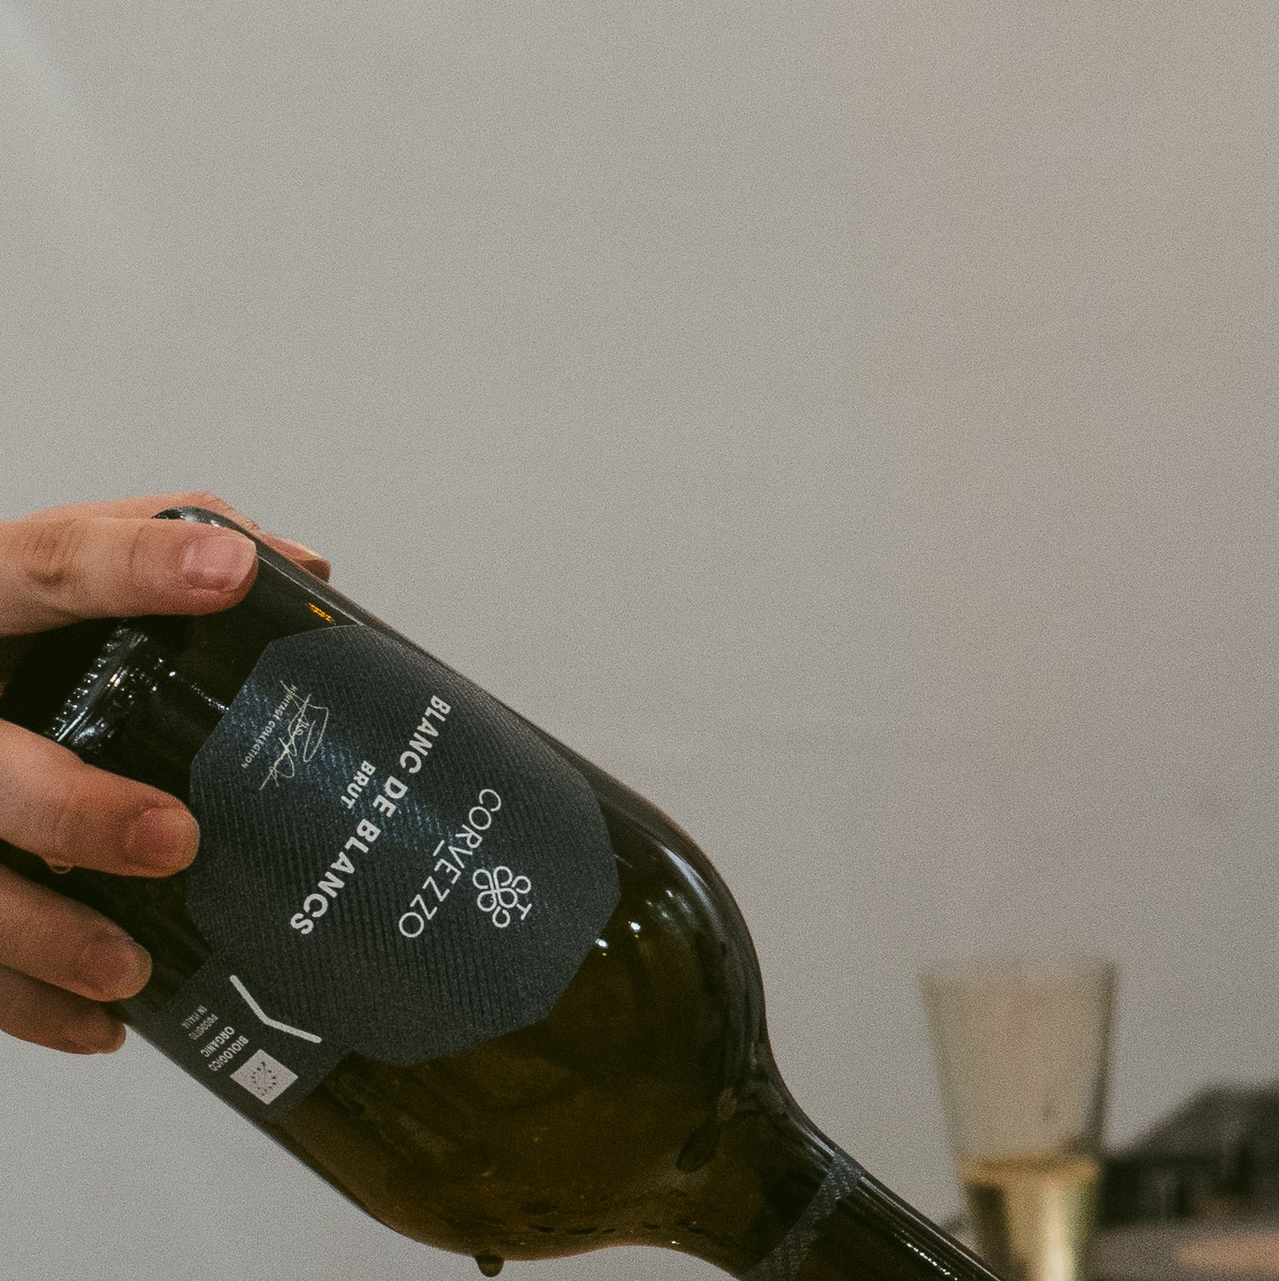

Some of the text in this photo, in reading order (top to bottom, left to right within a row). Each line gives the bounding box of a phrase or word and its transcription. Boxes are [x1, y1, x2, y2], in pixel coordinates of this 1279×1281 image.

[272, 684, 298, 720] HERITAGE
[241, 720, 276, 769] COLLECTION
[399, 695, 451, 774] BLANC
[341, 760, 376, 809] BRUT
[372, 775, 408, 818] DE
[290, 819, 381, 935] BLANCS
[399, 789, 501, 938] CORVEZZO
[197, 1004, 208, 1015] IN
[200, 1026, 235, 1057] ORGANIC
[208, 1035, 249, 1071] BIOLOGICO
